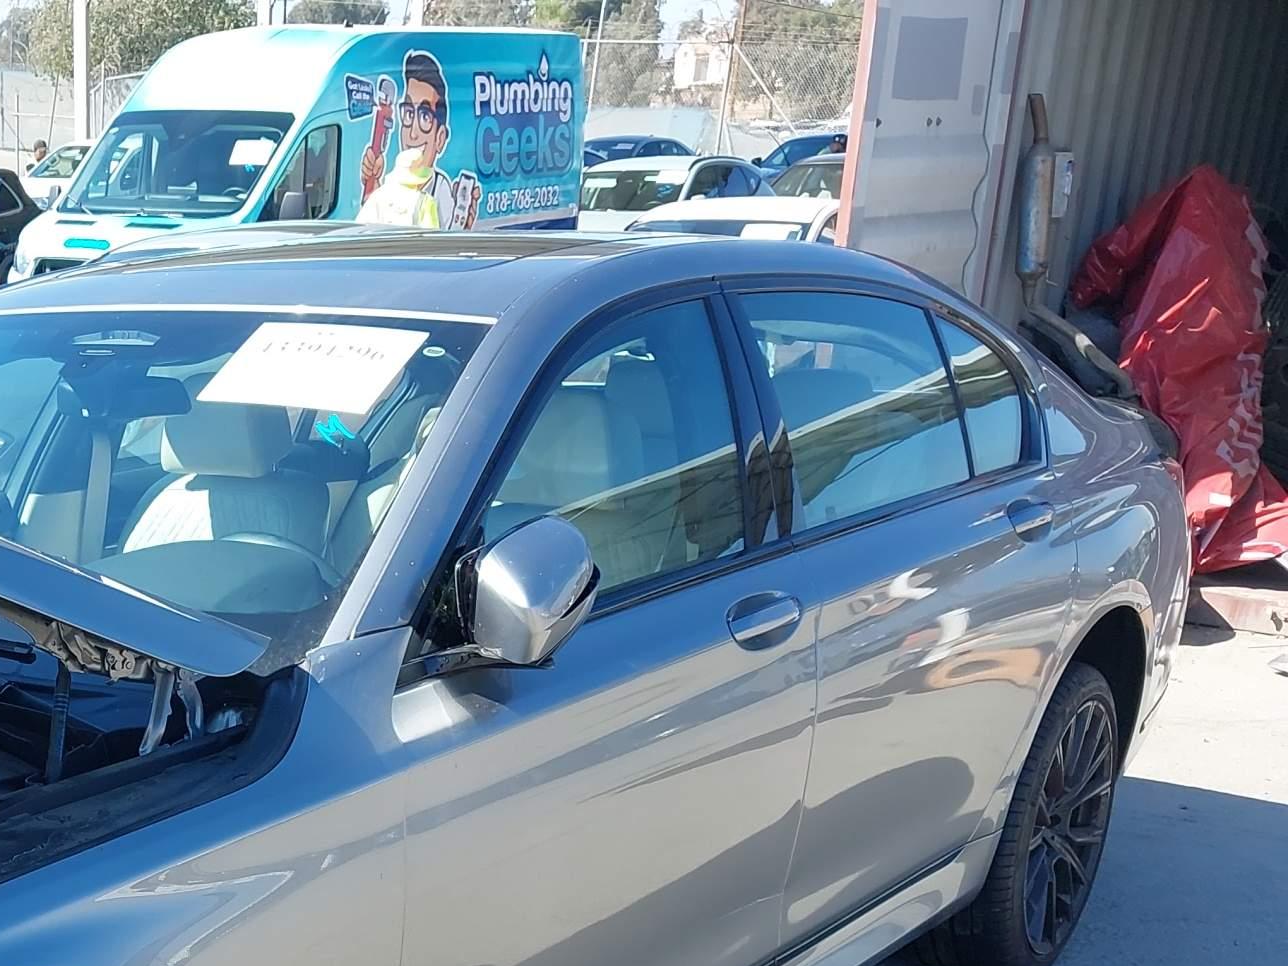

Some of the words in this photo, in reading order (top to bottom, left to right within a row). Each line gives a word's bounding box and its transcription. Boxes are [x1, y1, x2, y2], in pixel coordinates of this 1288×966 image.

[474, 73, 572, 122] Plumbing
[476, 114, 571, 173] Geeks
[486, 185, 560, 213] 818-768-2032
